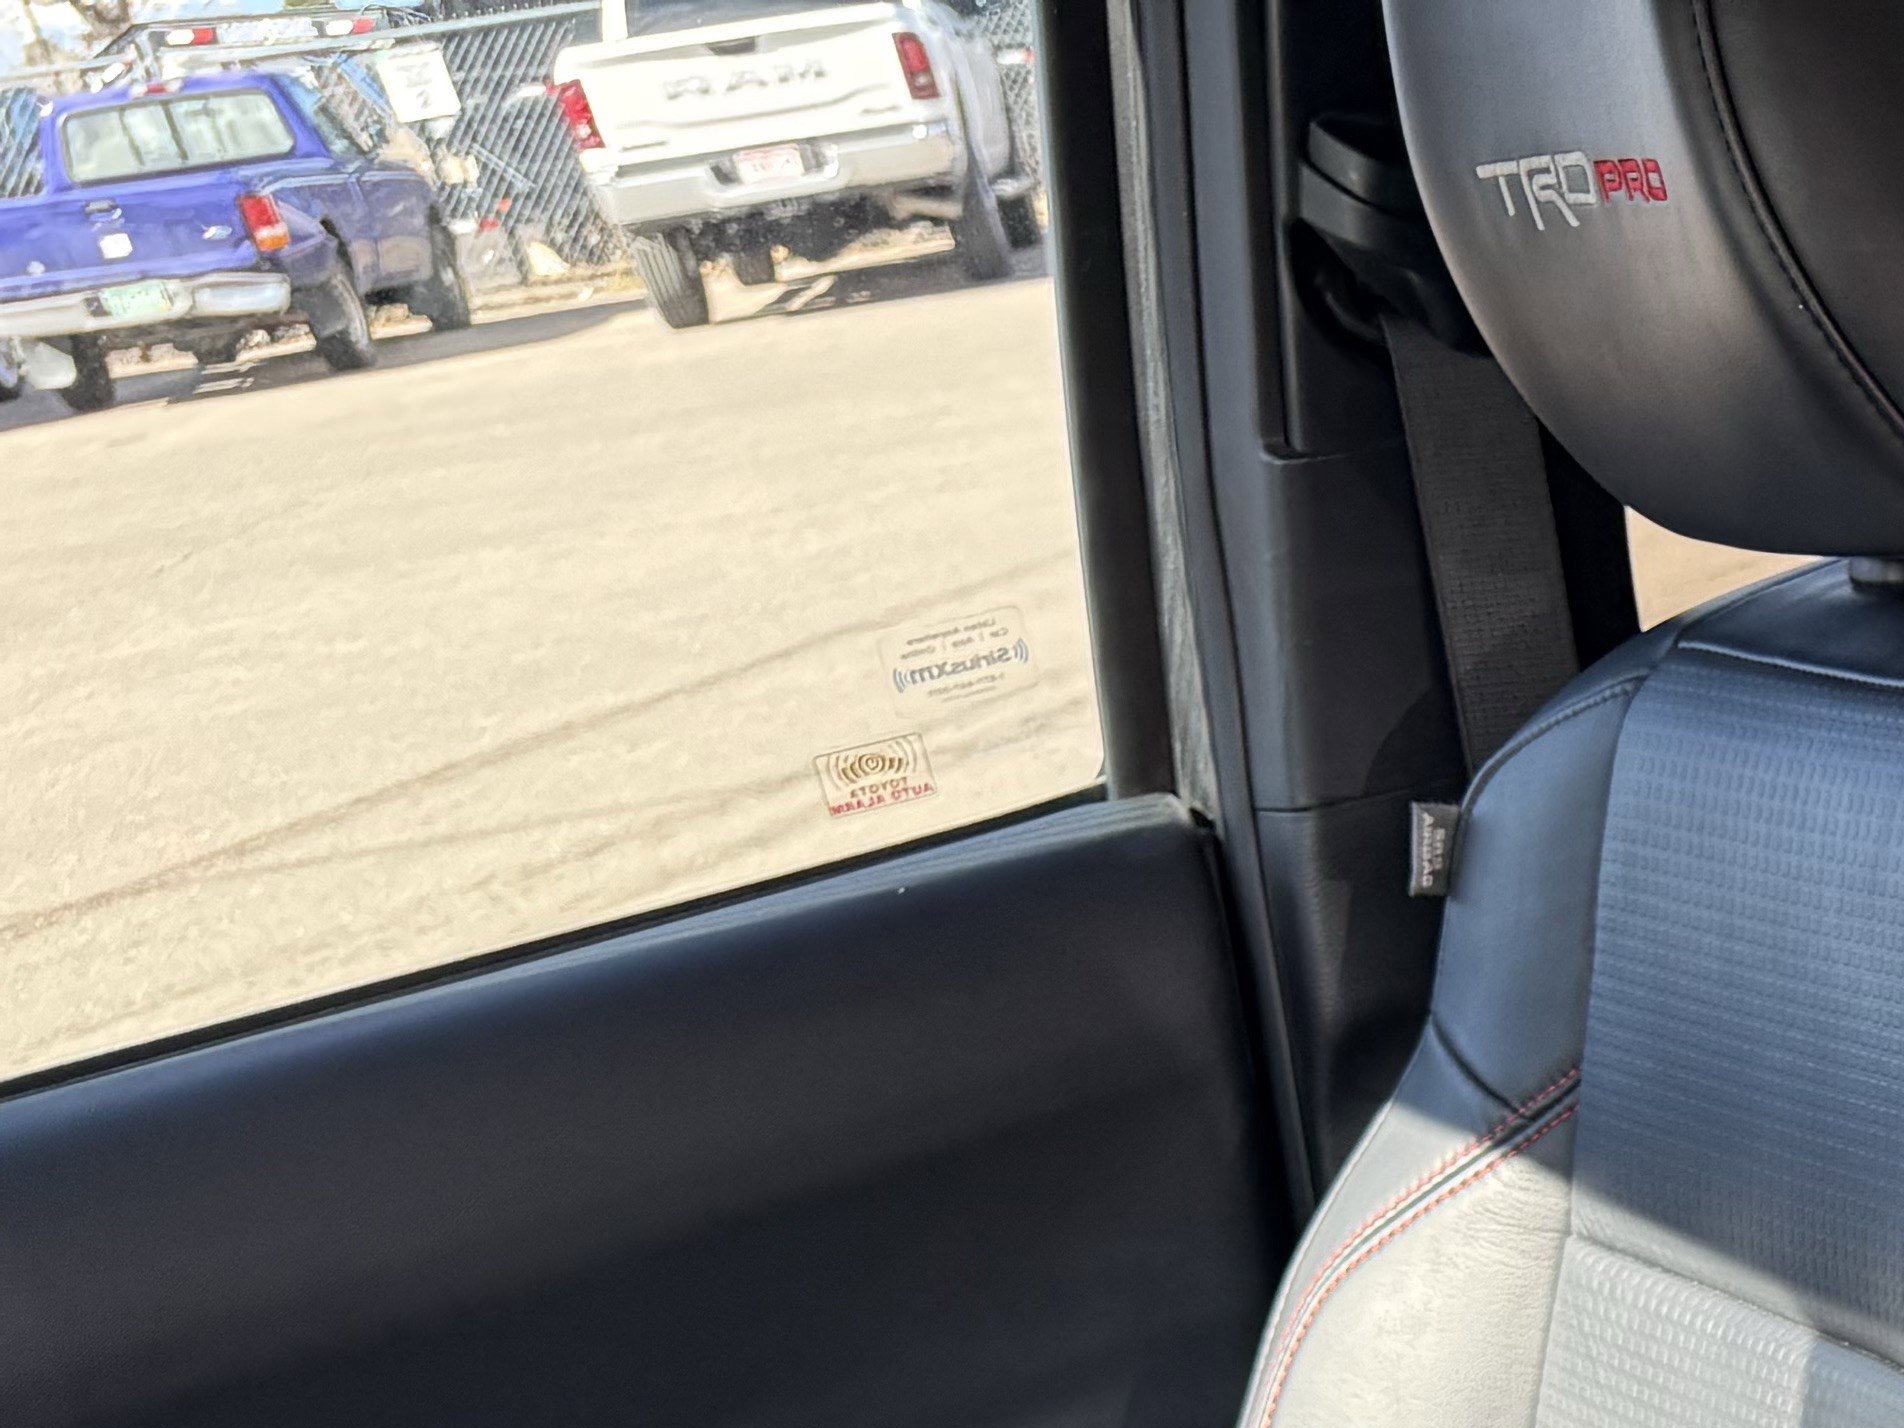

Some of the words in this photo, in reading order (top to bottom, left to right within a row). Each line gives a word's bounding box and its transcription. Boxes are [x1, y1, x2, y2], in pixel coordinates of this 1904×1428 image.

[663, 60, 827, 100] RAM
[1476, 150, 1598, 231] TRD
[1594, 157, 1669, 203] PRO
